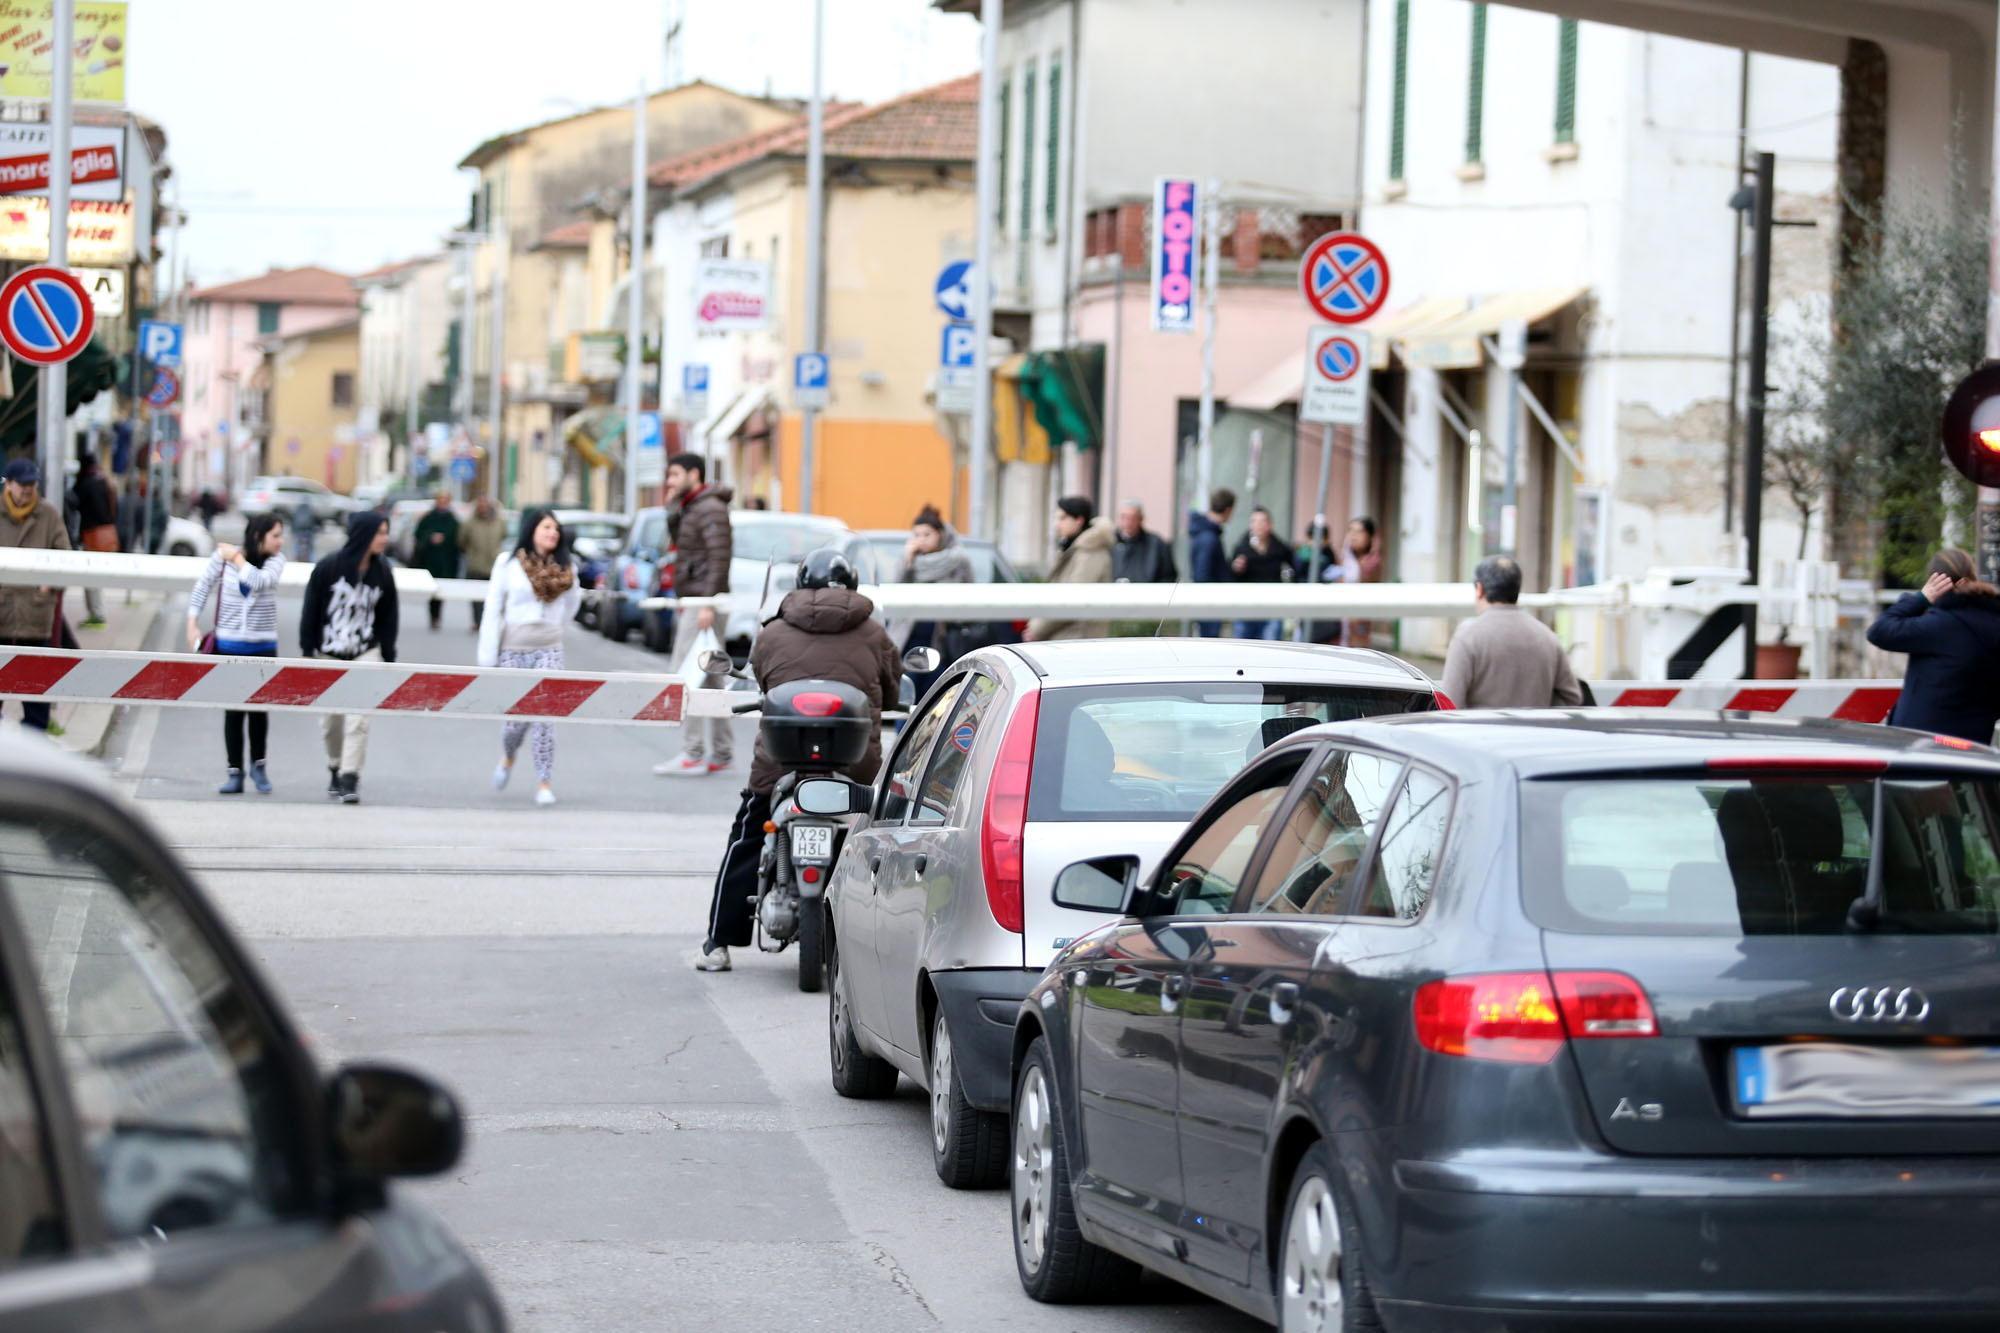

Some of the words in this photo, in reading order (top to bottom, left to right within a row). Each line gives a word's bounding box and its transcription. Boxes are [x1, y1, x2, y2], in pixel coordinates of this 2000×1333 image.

[0, 150, 113, 183] maraglia
[1161, 182, 1192, 304] FOTO
[146, 326, 175, 361] P
[801, 357, 823, 388] P
[798, 843, 826, 856] H3L
[799, 828, 827, 842] X29
[1609, 1097, 1664, 1121] A3
